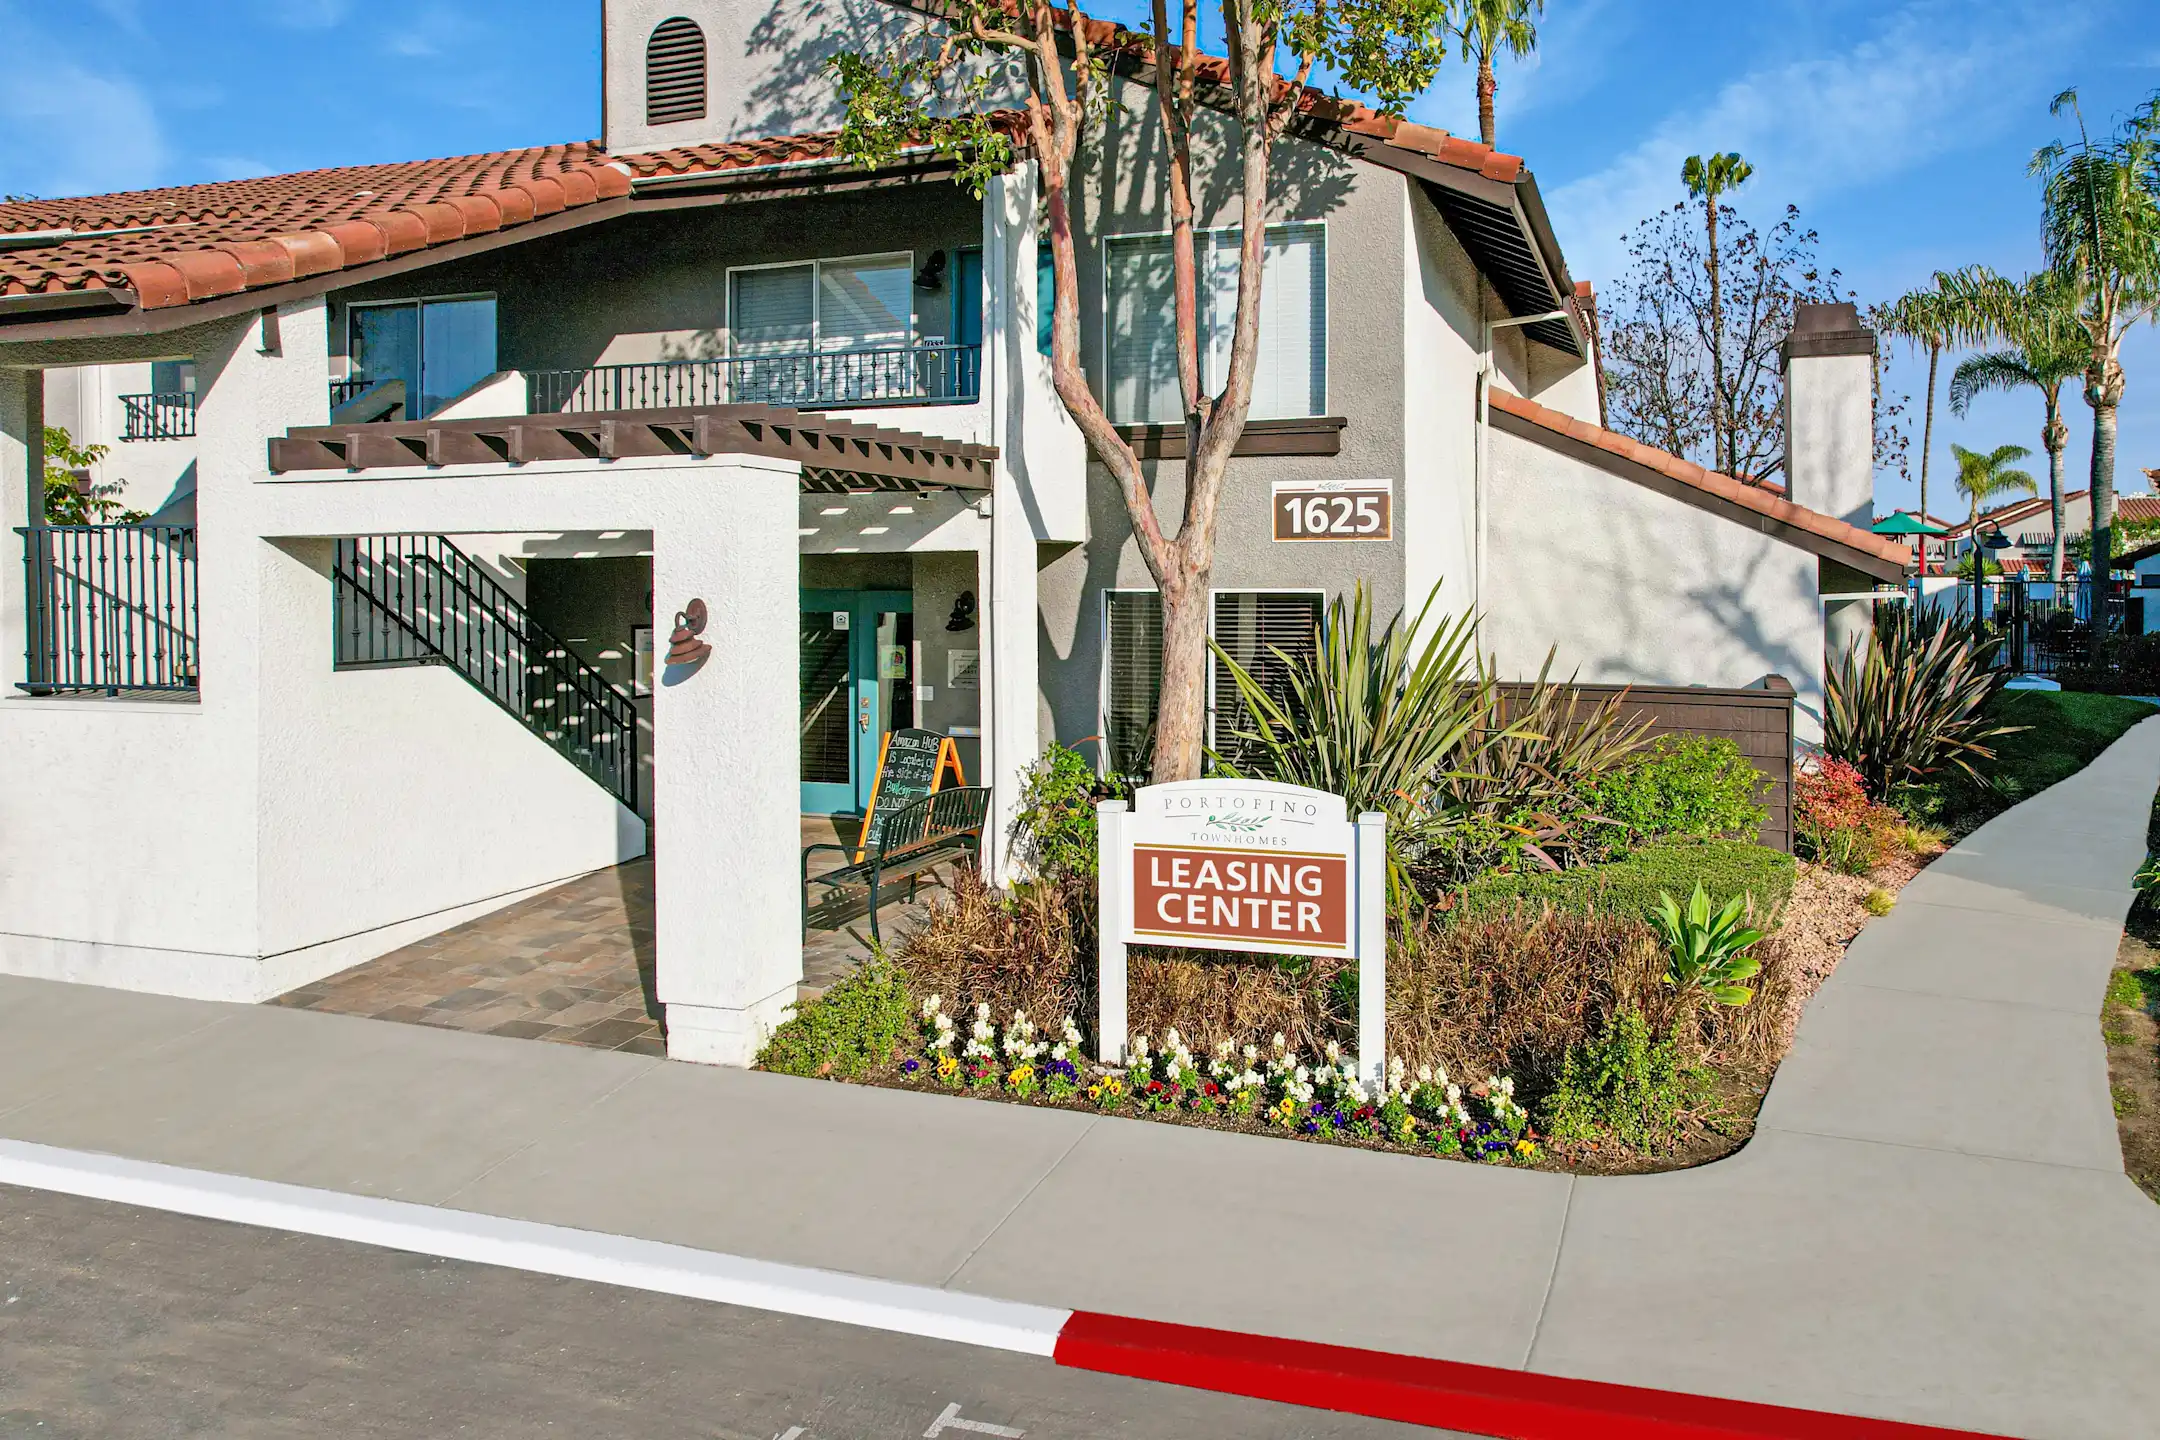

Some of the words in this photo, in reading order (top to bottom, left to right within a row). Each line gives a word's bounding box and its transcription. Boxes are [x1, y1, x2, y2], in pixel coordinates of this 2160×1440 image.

[1284, 496, 1380, 533] 1625
[889, 730, 919, 748] Amazon
[1164, 797, 1317, 817] PORTOFINO
[1191, 833, 1287, 846] TOWNHOMES
[1151, 856, 1322, 896] LEASING
[1157, 893, 1322, 933] CENTER
